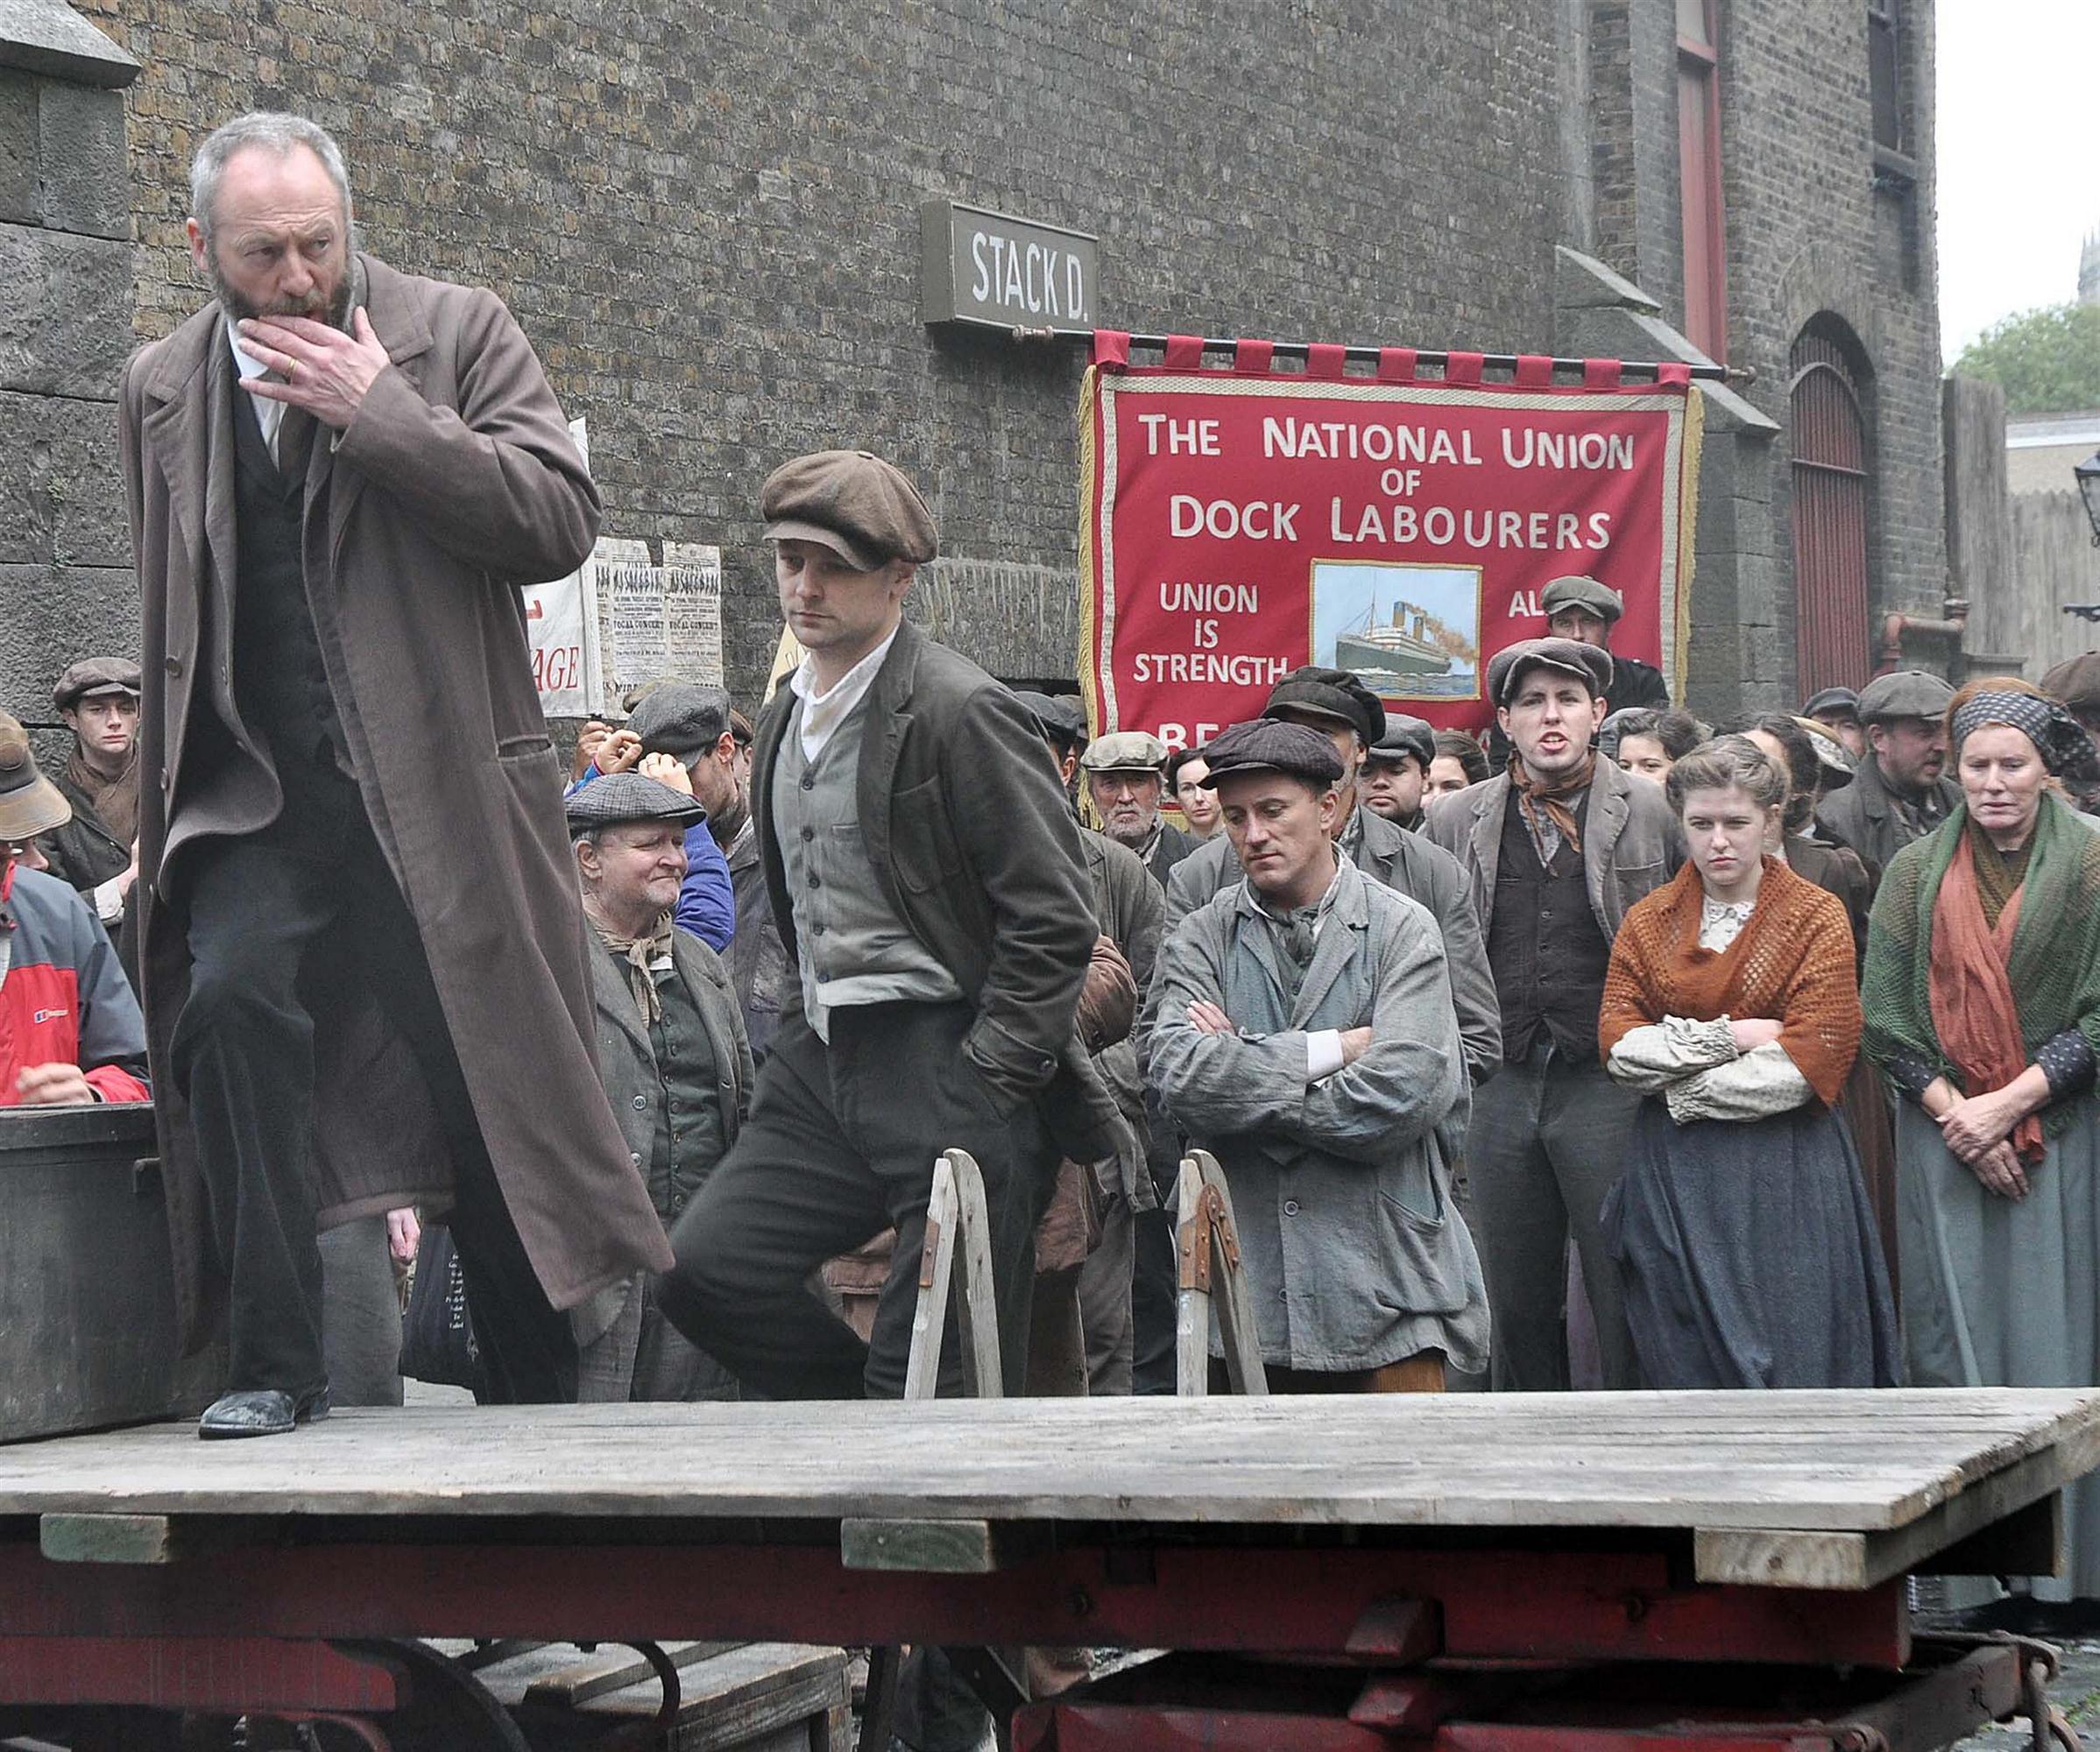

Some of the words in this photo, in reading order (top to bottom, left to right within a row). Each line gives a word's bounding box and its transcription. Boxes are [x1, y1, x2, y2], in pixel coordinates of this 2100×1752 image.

[972, 230, 1059, 317] STACK
[1065, 252, 1089, 322] D.
[1138, 413, 1222, 456] THE
[1262, 416, 1483, 467] NATIONAL
[1501, 427, 1636, 471] UNION
[1380, 467, 1422, 498] OF
[1170, 494, 1301, 541] DOCK
[1330, 496, 1612, 551] LABOURERS
[1159, 582, 1259, 614] UNION
[1194, 618, 1220, 649] IS
[1133, 653, 1289, 686] STRENGTH
